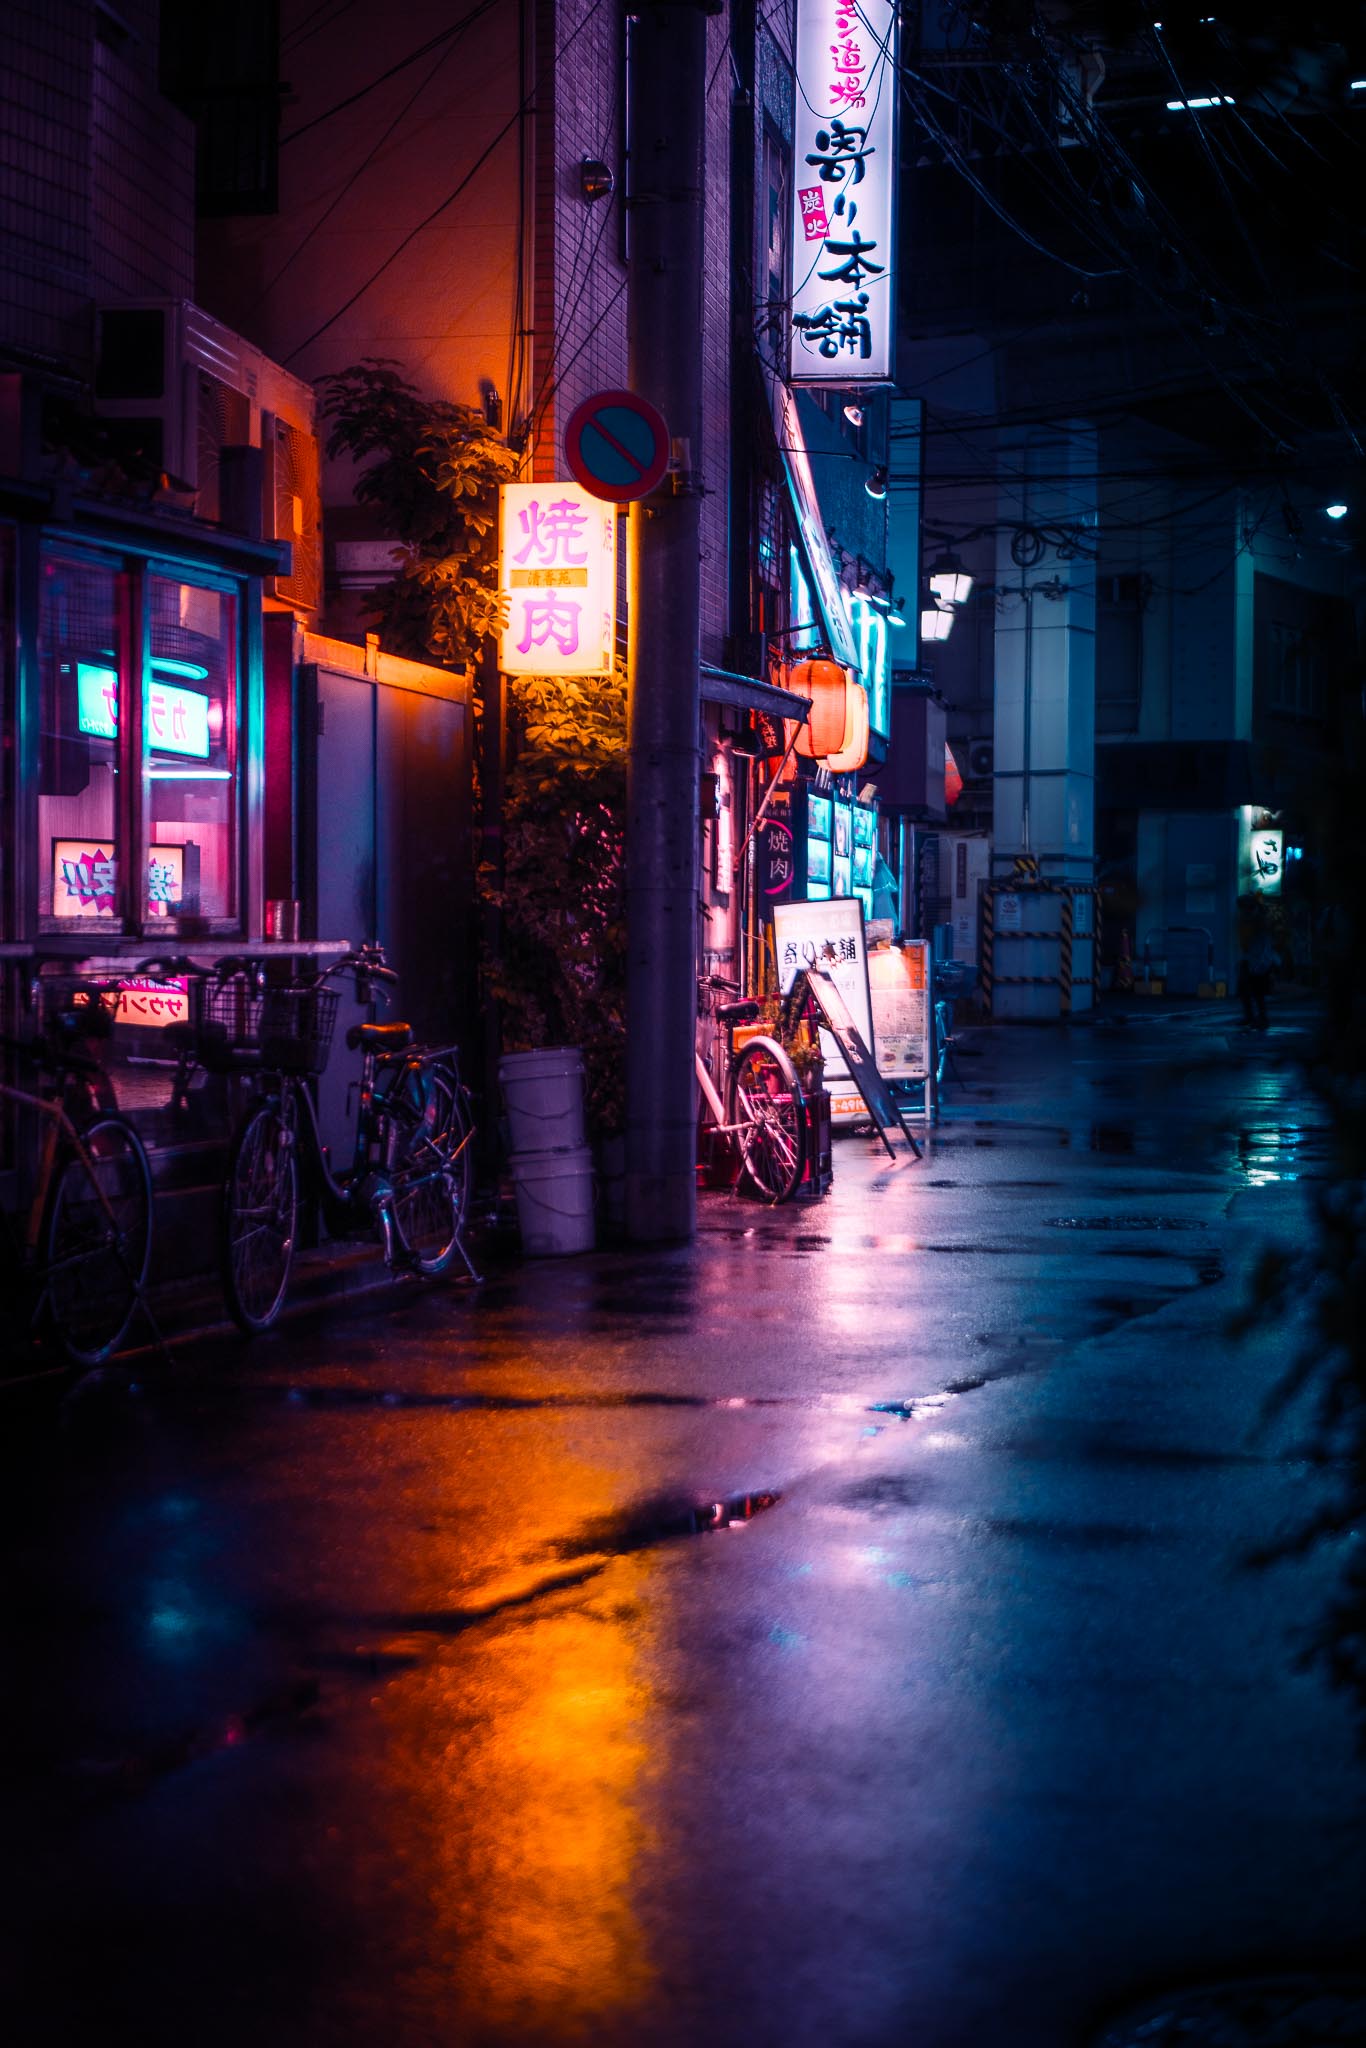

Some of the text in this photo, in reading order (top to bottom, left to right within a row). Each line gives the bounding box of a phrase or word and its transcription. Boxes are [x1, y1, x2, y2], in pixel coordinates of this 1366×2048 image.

[792, 119, 885, 359] 寄り本舗
[800, 190, 829, 237] 炭火
[512, 498, 589, 656] 焼肉
[768, 829, 789, 880] 焼肉
